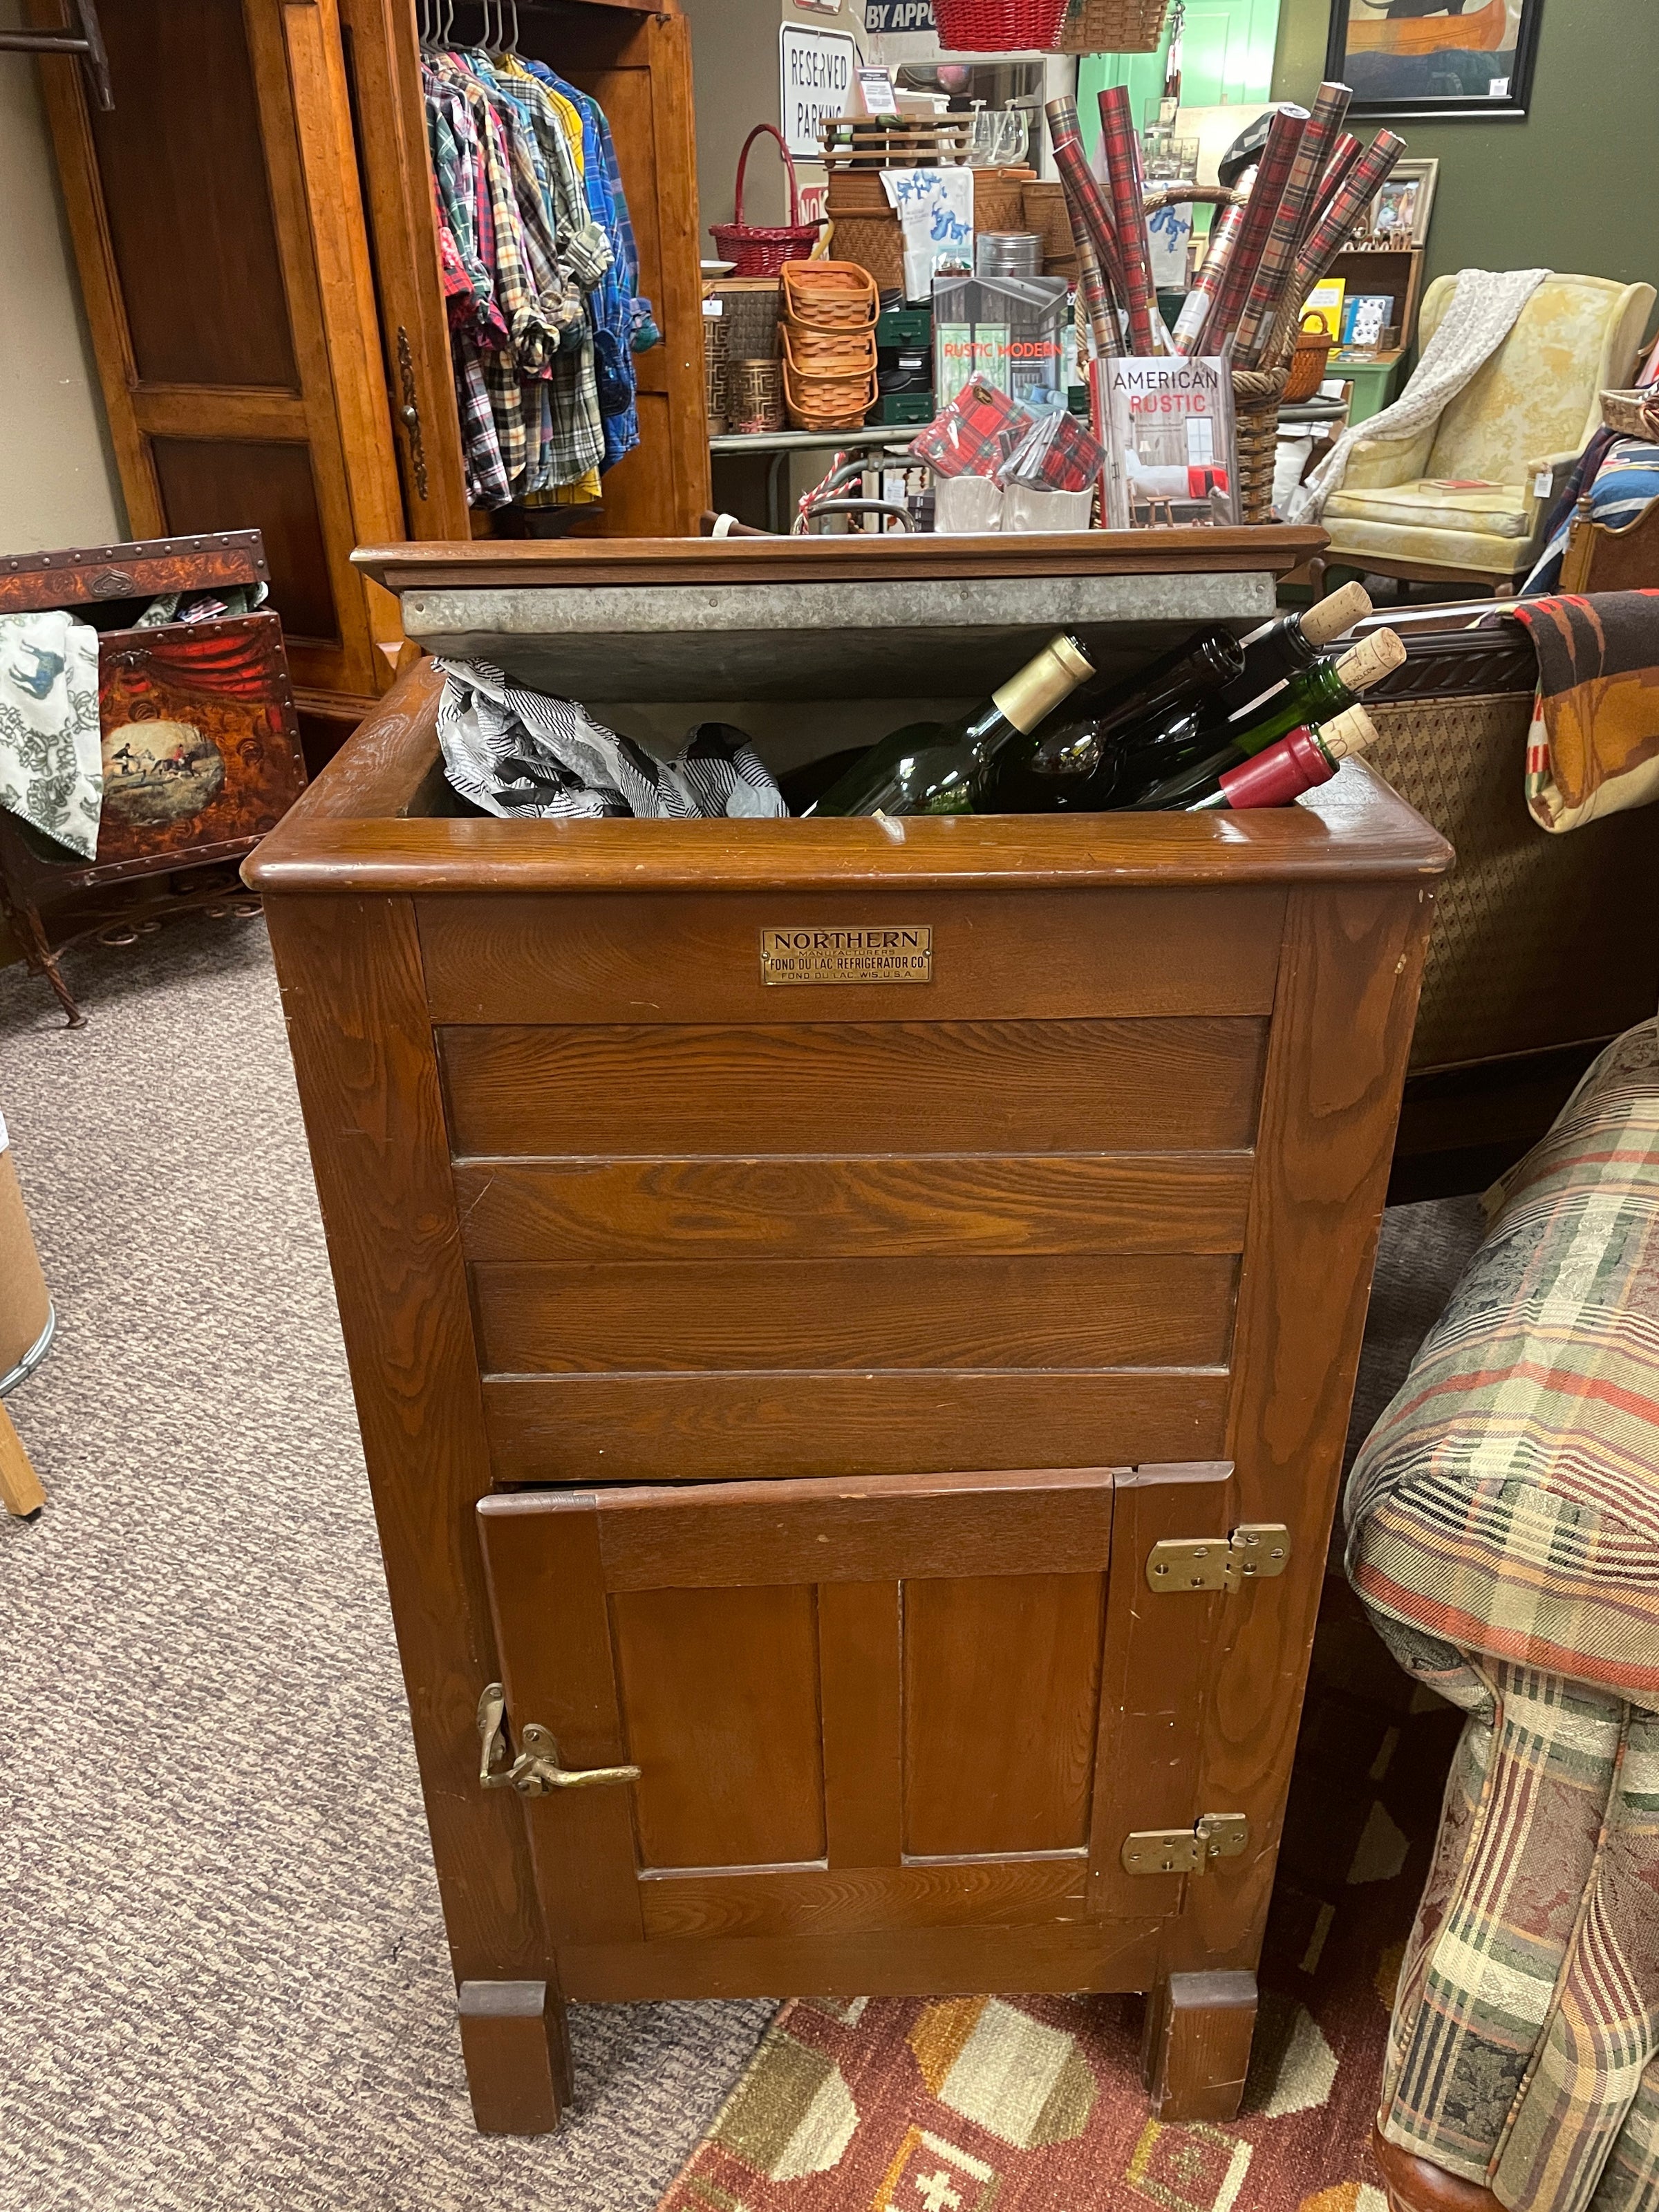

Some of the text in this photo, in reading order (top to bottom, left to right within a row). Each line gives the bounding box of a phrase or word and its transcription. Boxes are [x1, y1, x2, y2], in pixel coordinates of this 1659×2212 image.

[865, 5, 890, 29] BY
[791, 48, 847, 91] RESERVED
[944, 341, 1063, 358] RUSTIC MODERN
[1113, 371, 1218, 390] AMERICAN
[1130, 395, 1206, 413] RUSTIC
[774, 931, 918, 950] NORTHERN
[770, 956, 926, 971] FOND DU LAC REFRIGERATOR CO.
